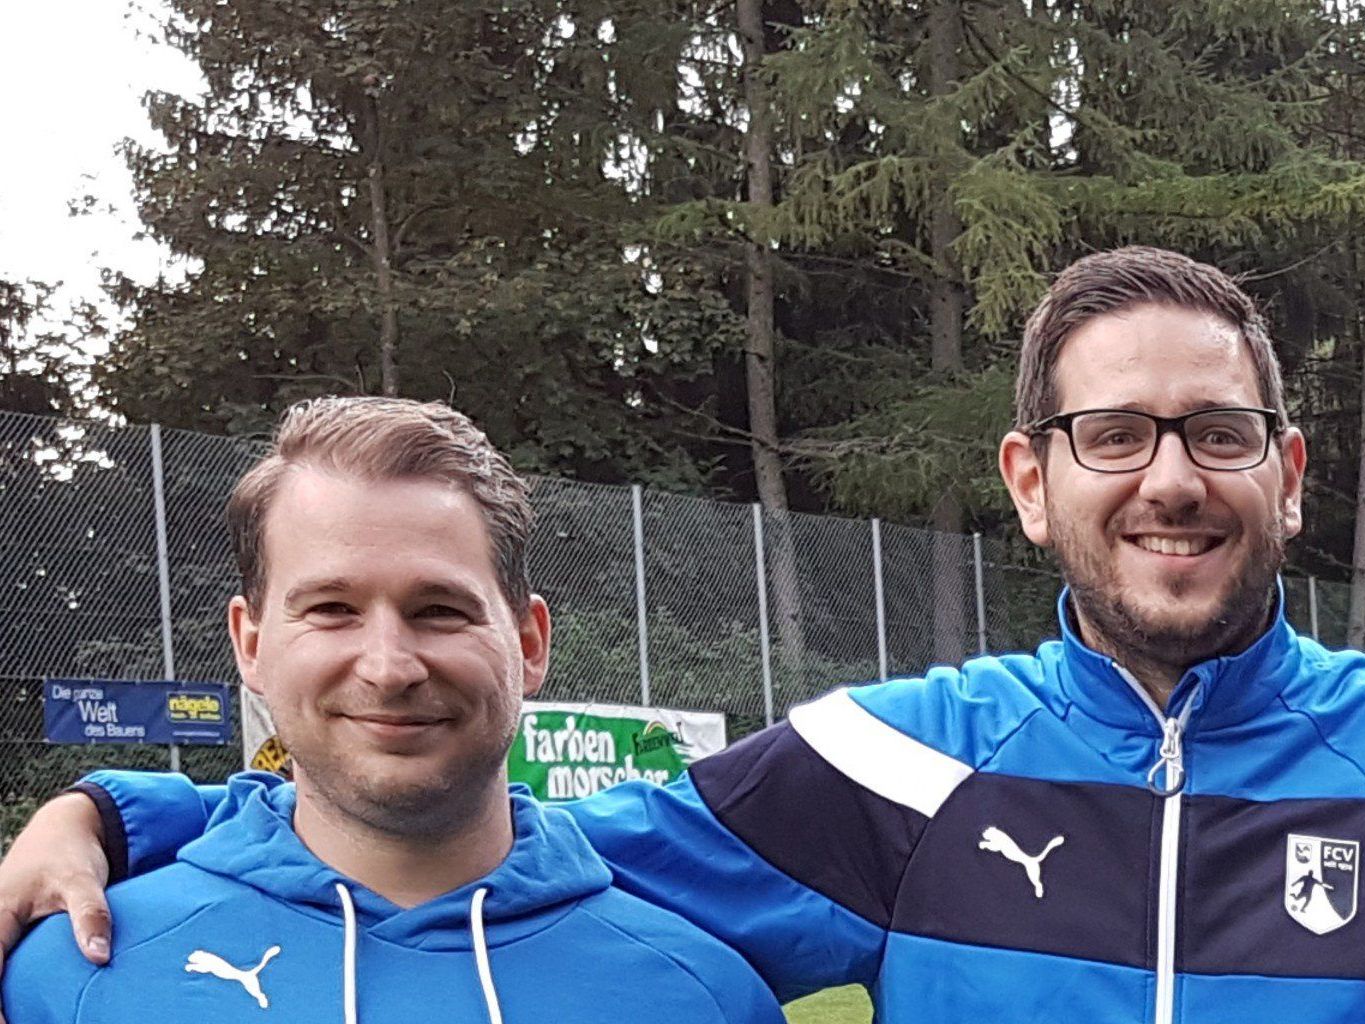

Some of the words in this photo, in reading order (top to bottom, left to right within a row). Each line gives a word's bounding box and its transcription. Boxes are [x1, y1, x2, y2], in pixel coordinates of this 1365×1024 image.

[52, 685, 71, 699] Die
[78, 700, 119, 722] Welt
[523, 714, 616, 763] farben
[1323, 846, 1354, 862] FCV
